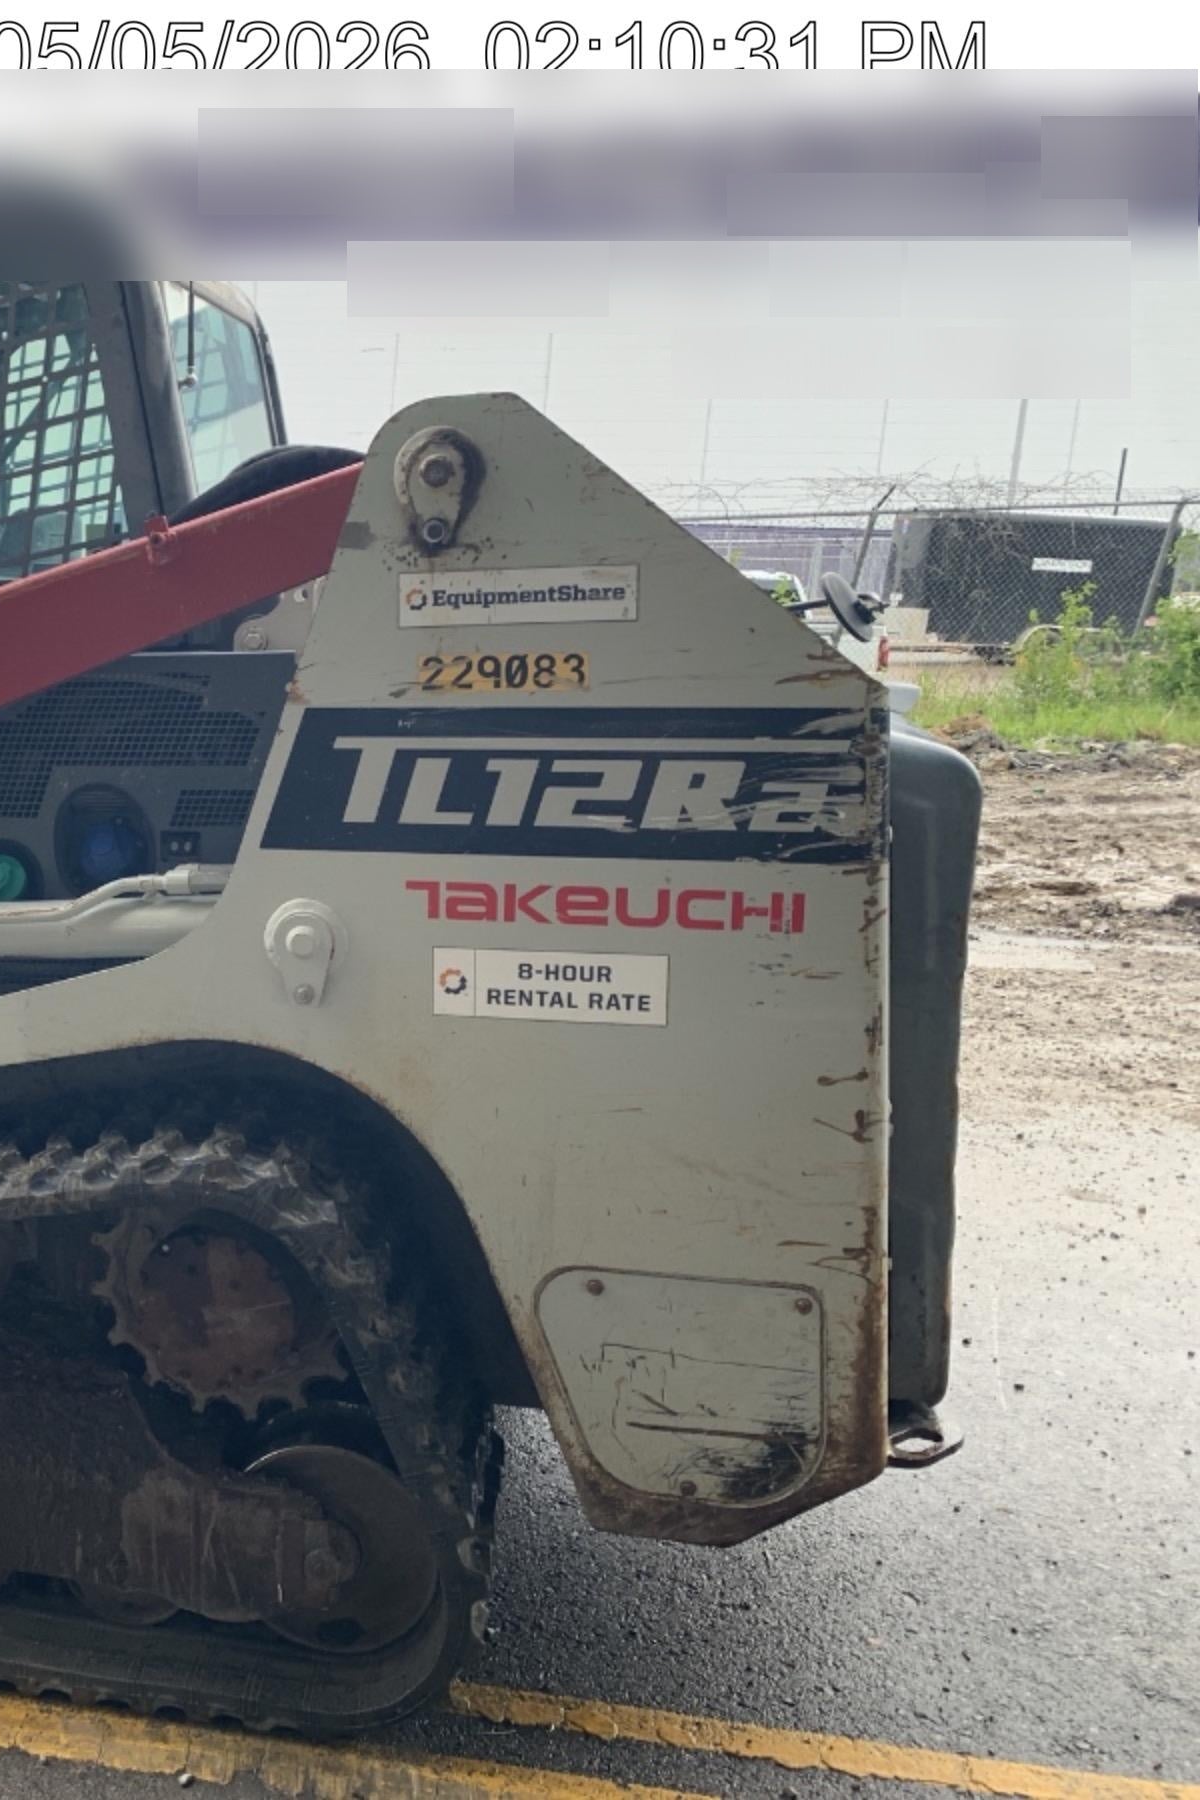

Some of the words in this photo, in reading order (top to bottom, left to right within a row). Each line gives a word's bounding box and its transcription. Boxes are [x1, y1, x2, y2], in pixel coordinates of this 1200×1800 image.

[431, 584, 626, 610] EquipmentShare
[421, 653, 586, 691] 229083
[517, 962, 613, 984] 8-HOUR
[486, 988, 579, 1010] RENTAL
[588, 992, 652, 1013] RATE
